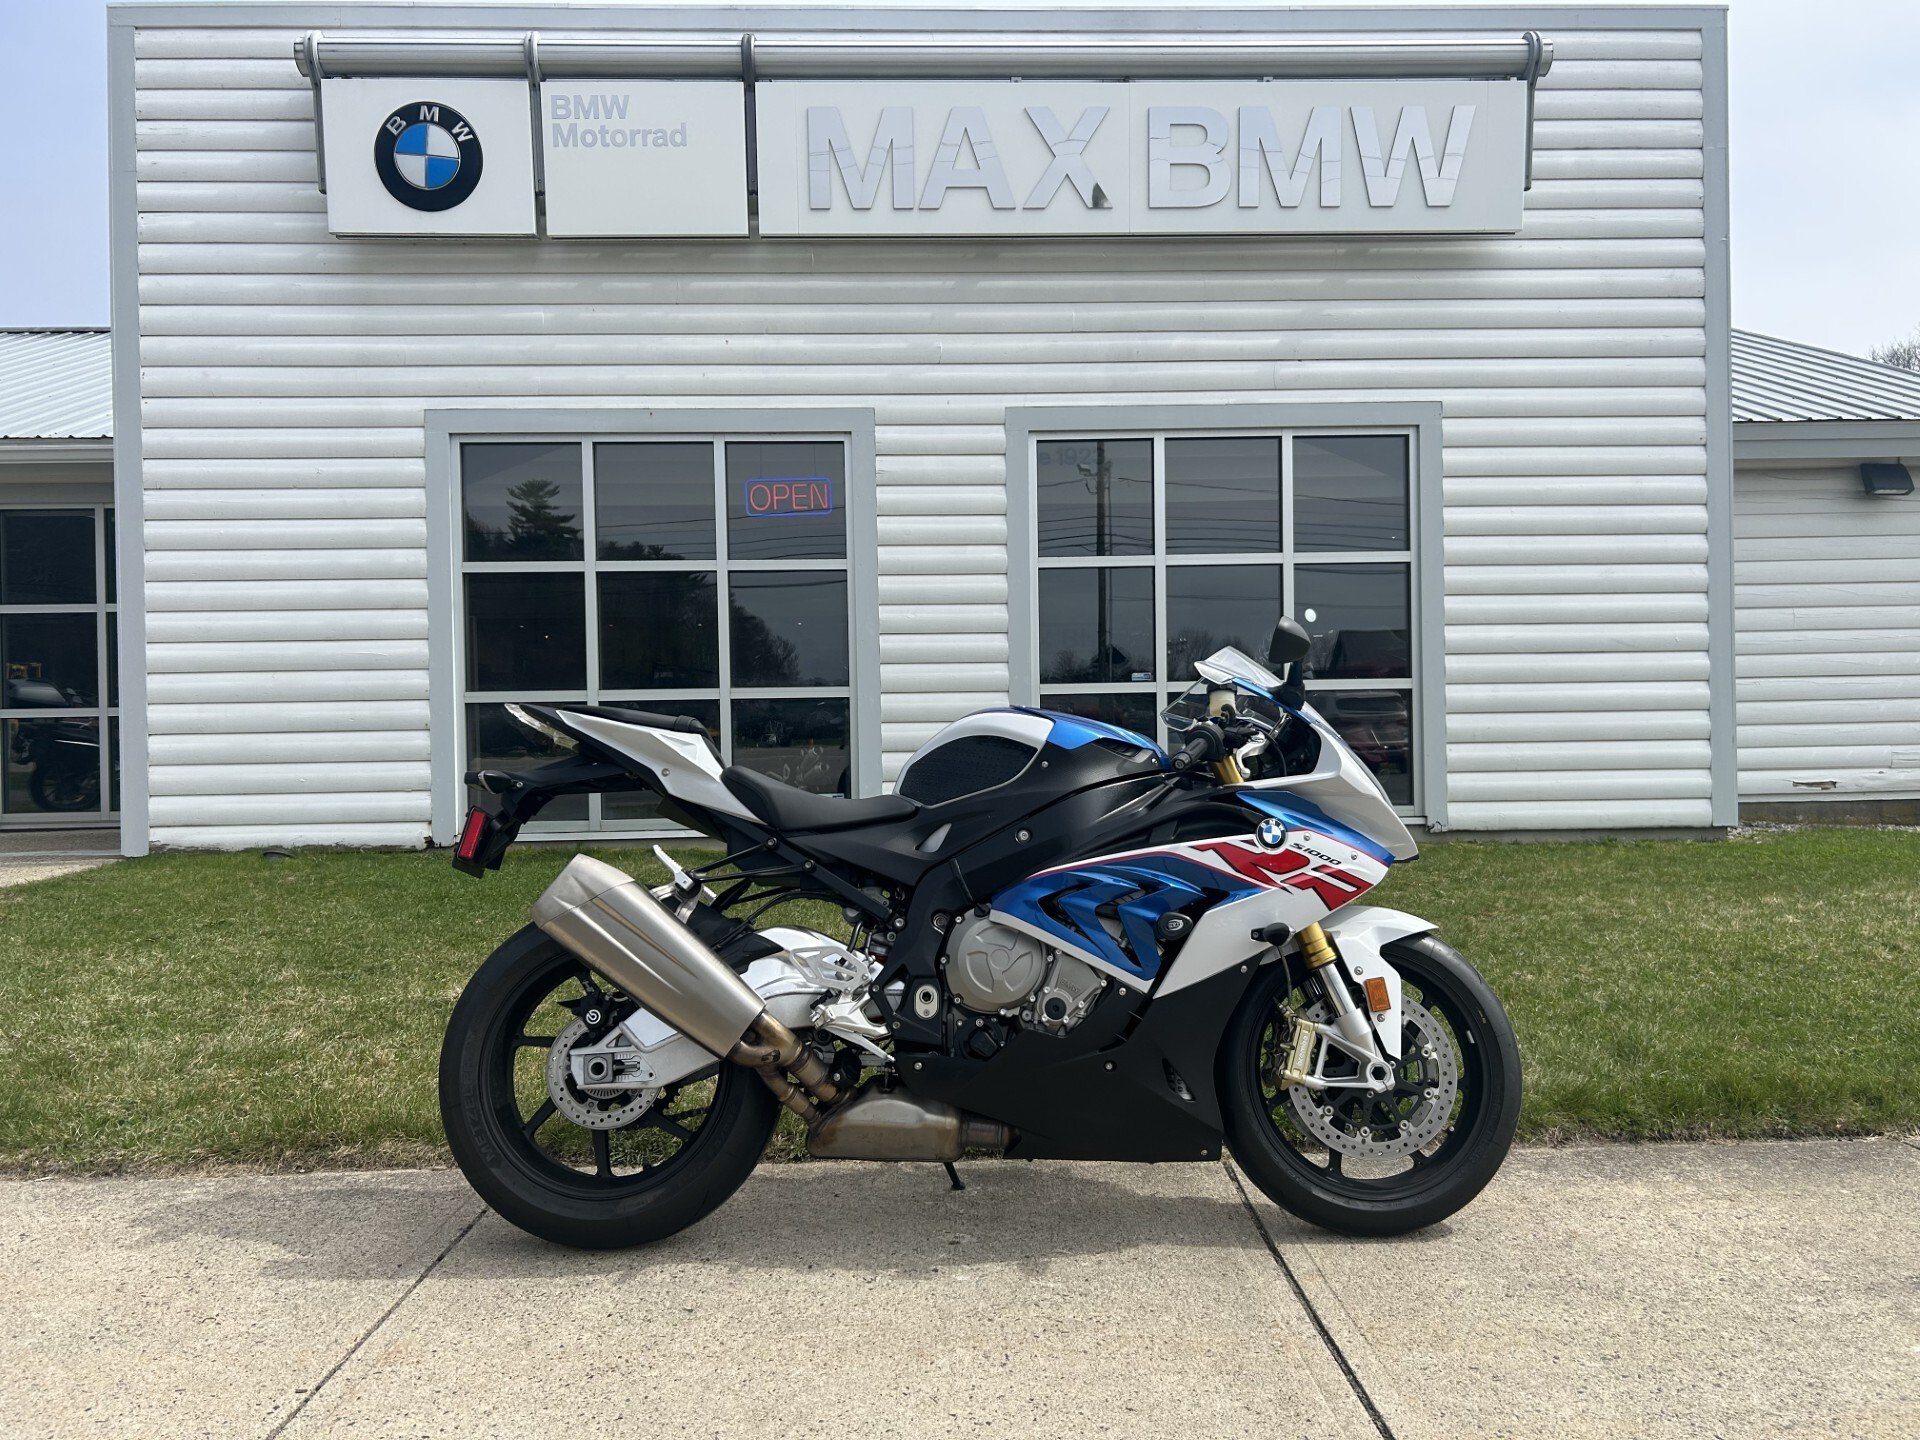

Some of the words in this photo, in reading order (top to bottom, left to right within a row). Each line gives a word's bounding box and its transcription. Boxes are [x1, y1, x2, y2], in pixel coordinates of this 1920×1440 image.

[550, 94, 630, 120] BMW
[385, 105, 474, 142] BMW
[552, 122, 687, 148] Motorrad
[807, 106, 1113, 210] MAX
[1148, 105, 1477, 209] BMW
[749, 482, 829, 511] OPEN
